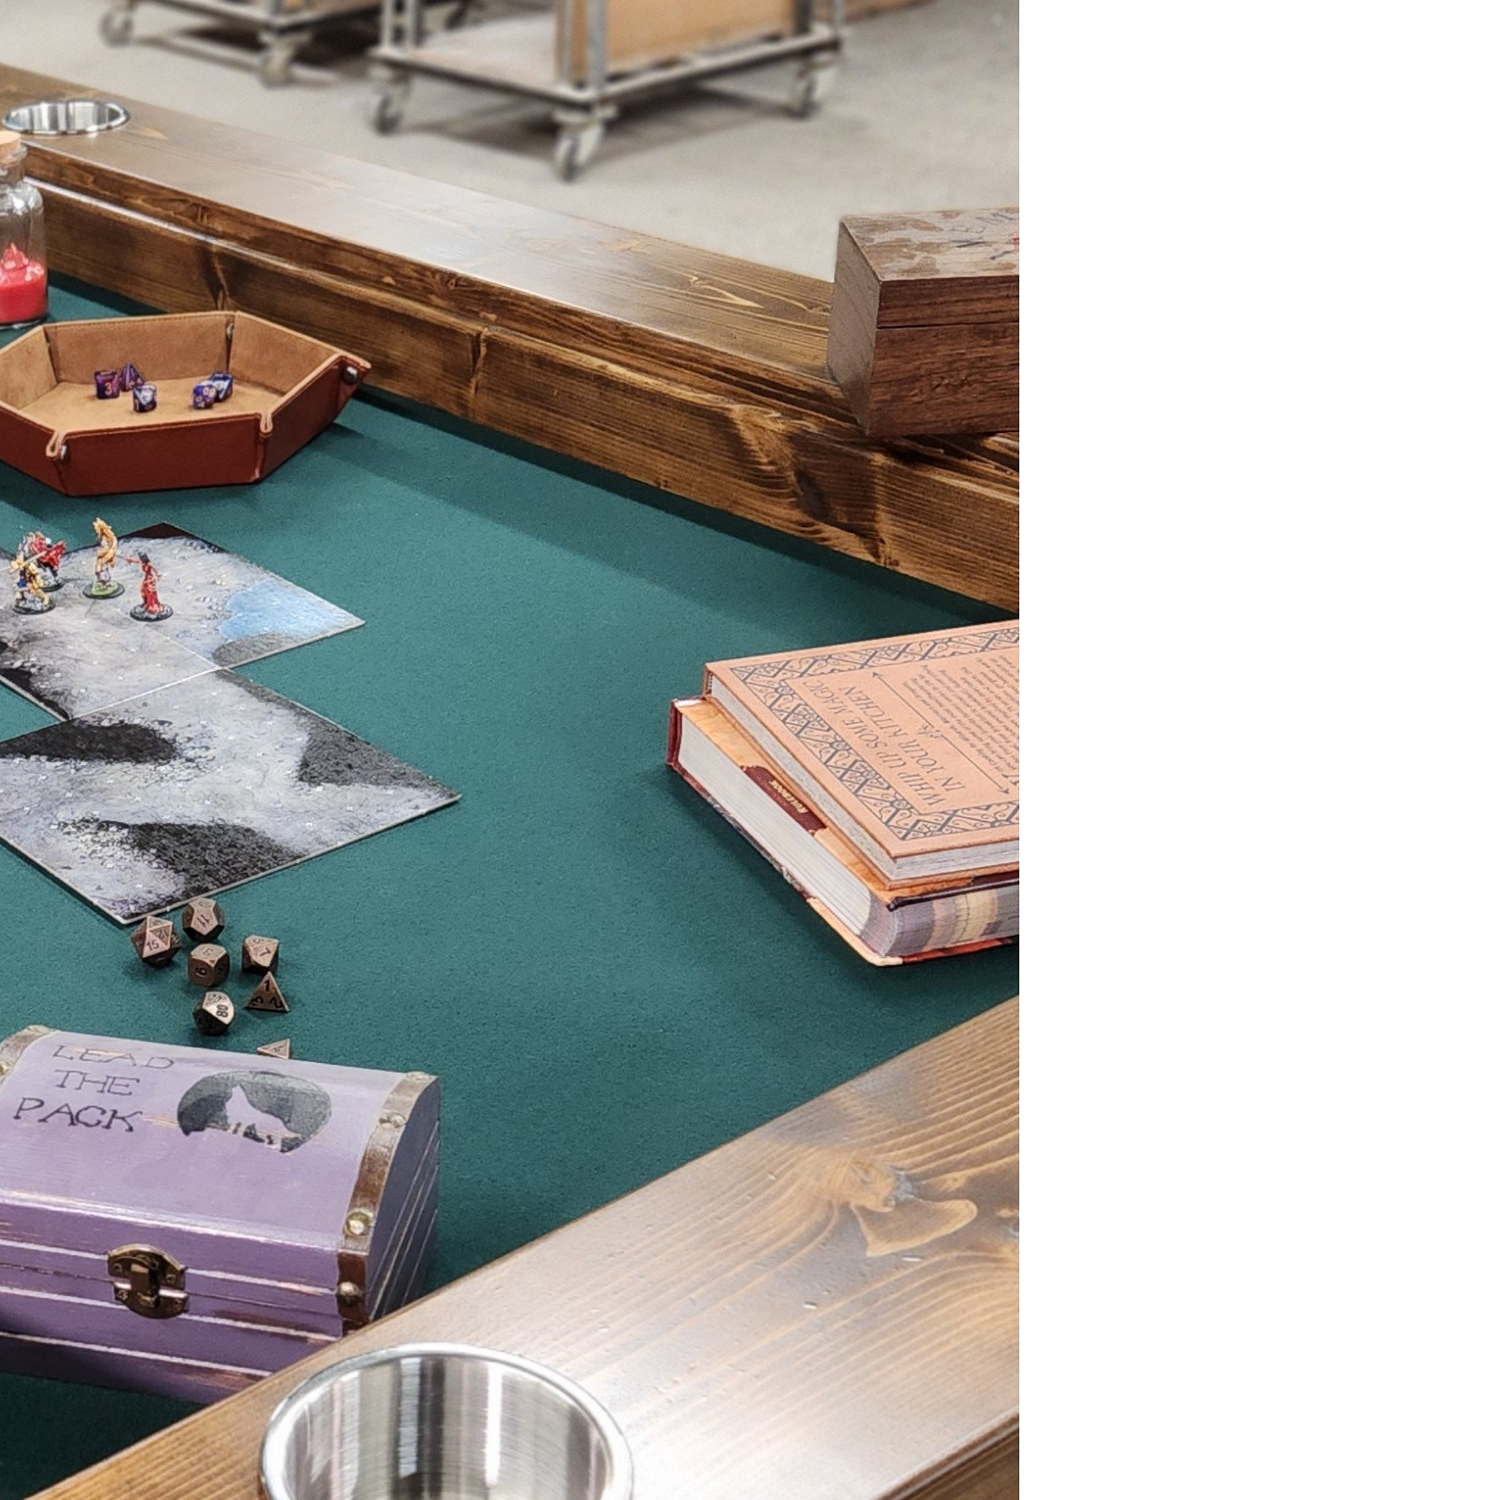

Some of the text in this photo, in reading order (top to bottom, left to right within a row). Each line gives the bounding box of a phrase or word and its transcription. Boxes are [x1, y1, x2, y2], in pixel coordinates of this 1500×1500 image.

[802, 680, 854, 715] MAGIC
[839, 685, 909, 738] KITCHEN
[842, 717, 887, 749] SOME
[876, 751, 907, 769] UP
[898, 739, 944, 773] YOUR
[897, 772, 946, 806] WHIP
[934, 777, 966, 792] IN
[146, 939, 161, 952] 15
[52, 1044, 175, 1070] LEAD
[53, 1068, 141, 1096] THE
[12, 1096, 144, 1133] PACK
